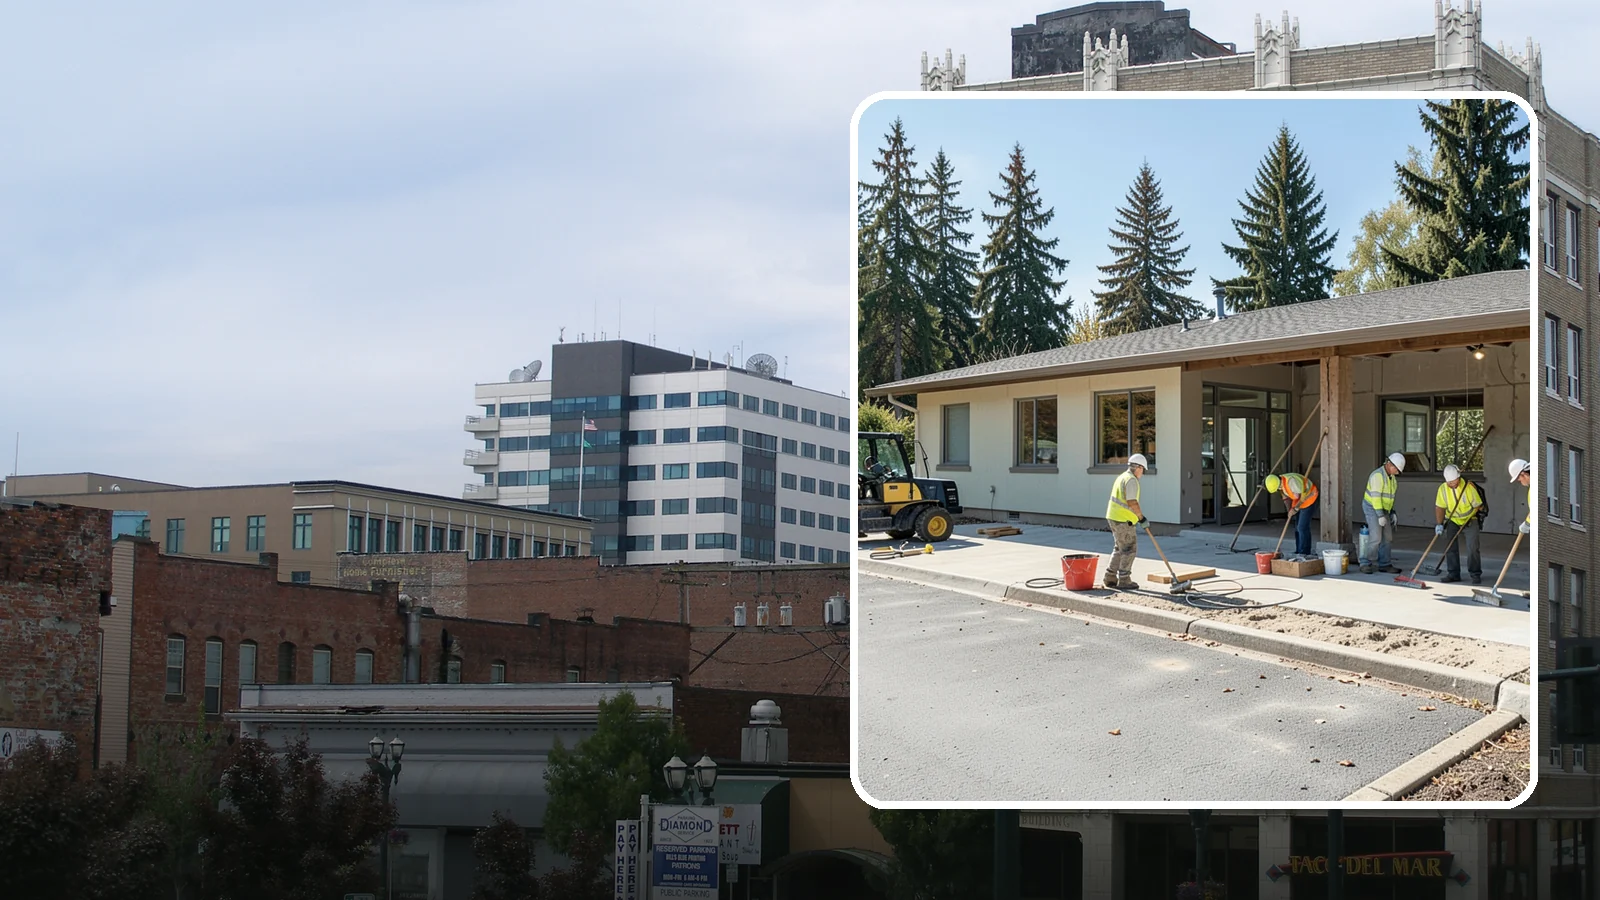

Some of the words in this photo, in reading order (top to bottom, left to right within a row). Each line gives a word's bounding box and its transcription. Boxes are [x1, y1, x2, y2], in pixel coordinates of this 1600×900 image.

[660, 818, 713, 833] DIAMOND
[1022, 815, 1070, 828] BUILDING
[720, 824, 740, 835] ETT
[617, 825, 625, 853] PAY
[629, 825, 637, 852] PAY
[721, 851, 739, 862] Soup
[671, 861, 701, 870] PATRONS
[1346, 856, 1385, 875] DEL
[1392, 857, 1443, 877] MAR
[616, 856, 625, 893] HERE
[627, 855, 636, 893] HERE
[660, 888, 682, 897] PUBLIC
[683, 889, 710, 898] PARKING
